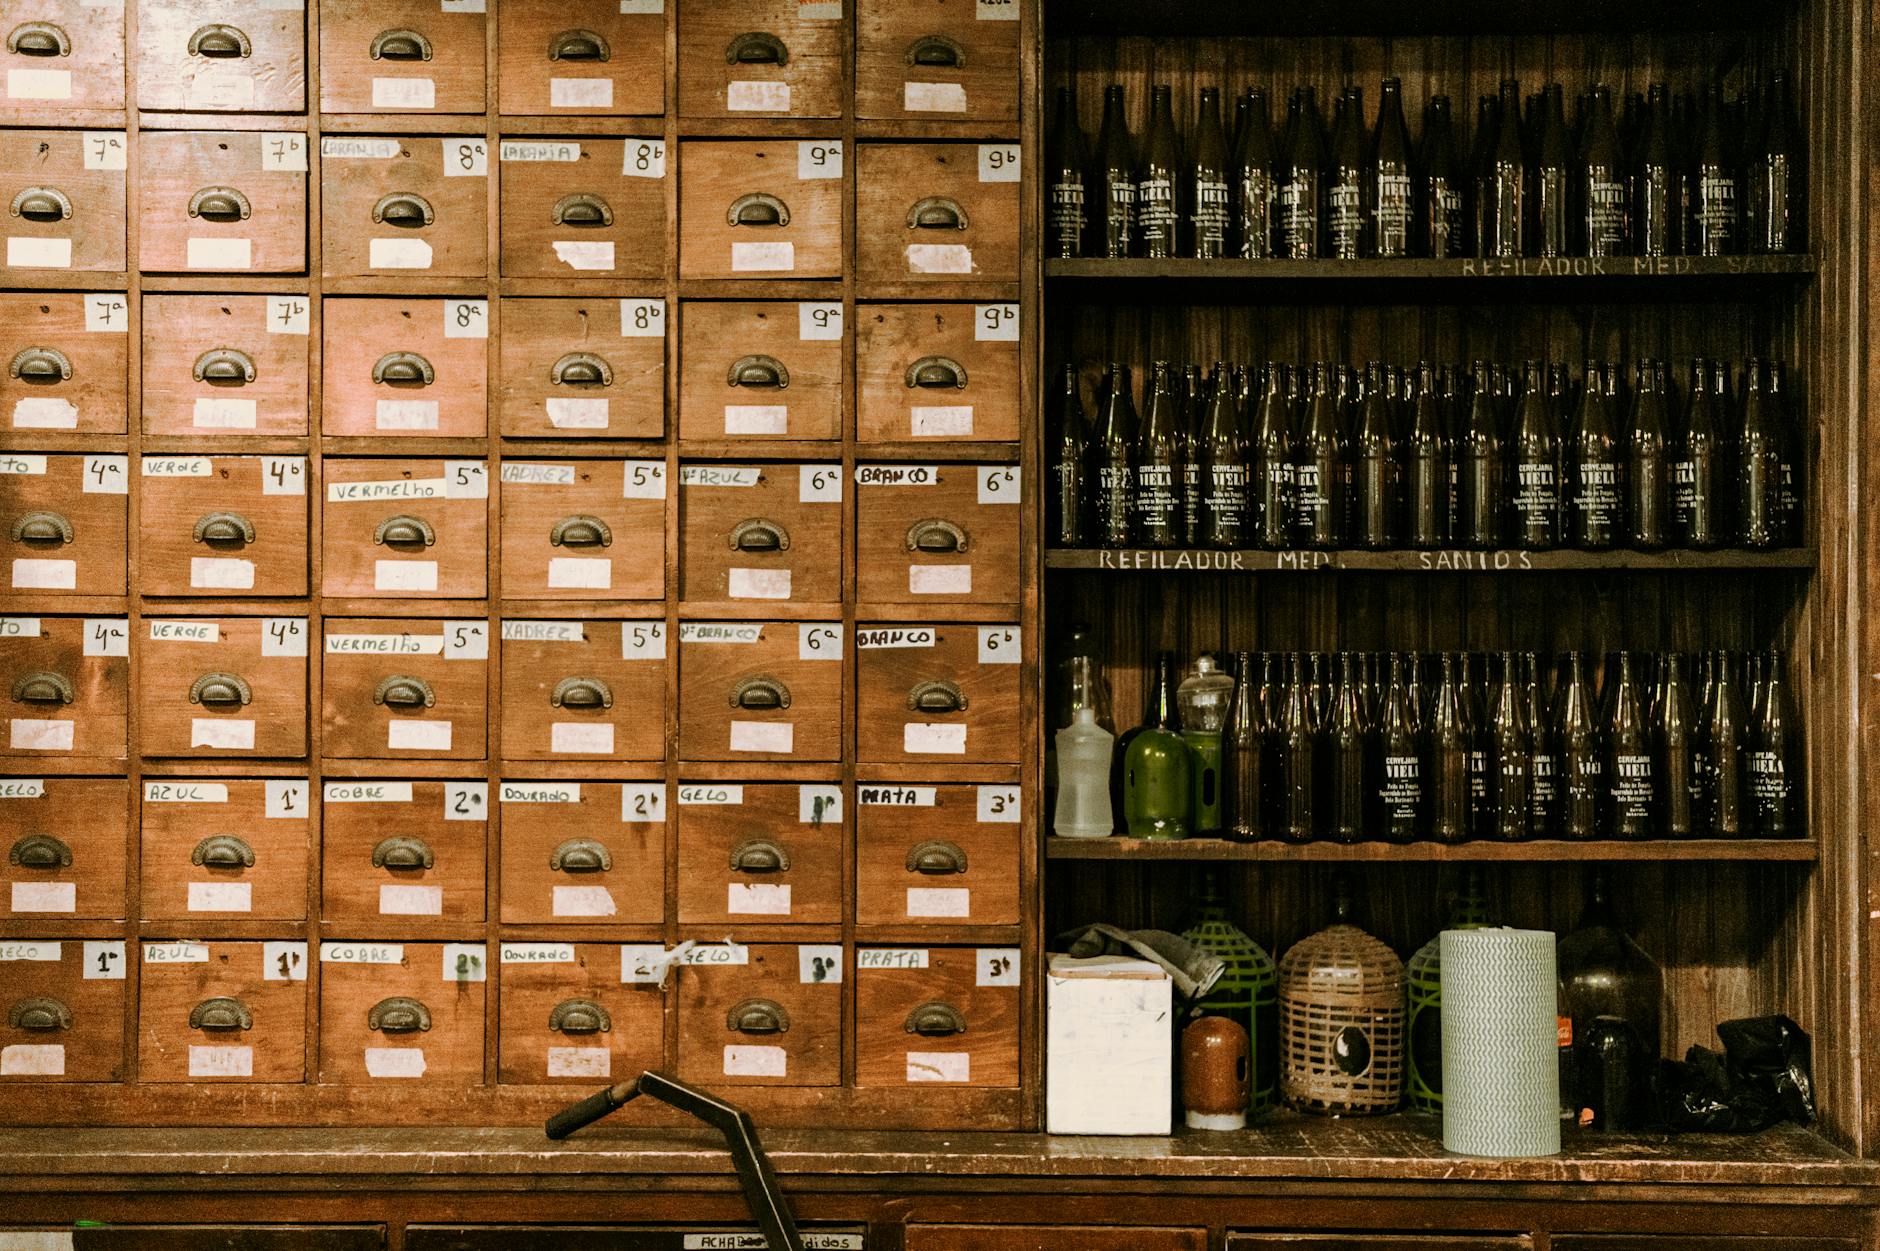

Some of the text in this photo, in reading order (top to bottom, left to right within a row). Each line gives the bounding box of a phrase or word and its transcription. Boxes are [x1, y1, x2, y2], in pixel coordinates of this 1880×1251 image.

[271, 139, 299, 163] 7b
[637, 144, 663, 169] 8b
[811, 147, 840, 165] 9a
[990, 151, 1015, 169] 9b
[1463, 257, 1606, 276] REFILADOR
[97, 302, 124, 324] 7a
[278, 302, 304, 324] 7b
[457, 304, 482, 326] 8a
[635, 305, 660, 328] 8b
[812, 309, 840, 327] 9a
[985, 307, 1014, 329] 9b
[91, 460, 120, 484] 4a
[271, 461, 300, 486] 4b
[456, 467, 482, 485] 5a
[633, 467, 661, 485] 5b
[699, 469, 749, 483] AZUL
[812, 472, 838, 490] 6a
[861, 468, 928, 483] BRANCO
[987, 472, 1013, 491] 6b
[1099, 551, 1244, 570] REFILADOR
[1419, 550, 1532, 569] SANTOS
[95, 624, 124, 650] 4a
[271, 621, 299, 645] 4b
[454, 627, 482, 647] 5a
[633, 624, 661, 647] 5b
[808, 629, 838, 649] 6a
[858, 631, 931, 646] BRANCO
[987, 630, 1012, 649] 6b
[150, 785, 204, 800] AZUL
[329, 787, 384, 799] COBRE
[681, 787, 728, 802] GELO
[148, 945, 195, 960] AZUL
[331, 947, 389, 961] COBRE
[684, 949, 730, 964] GELO
[861, 951, 920, 968] PRATA
